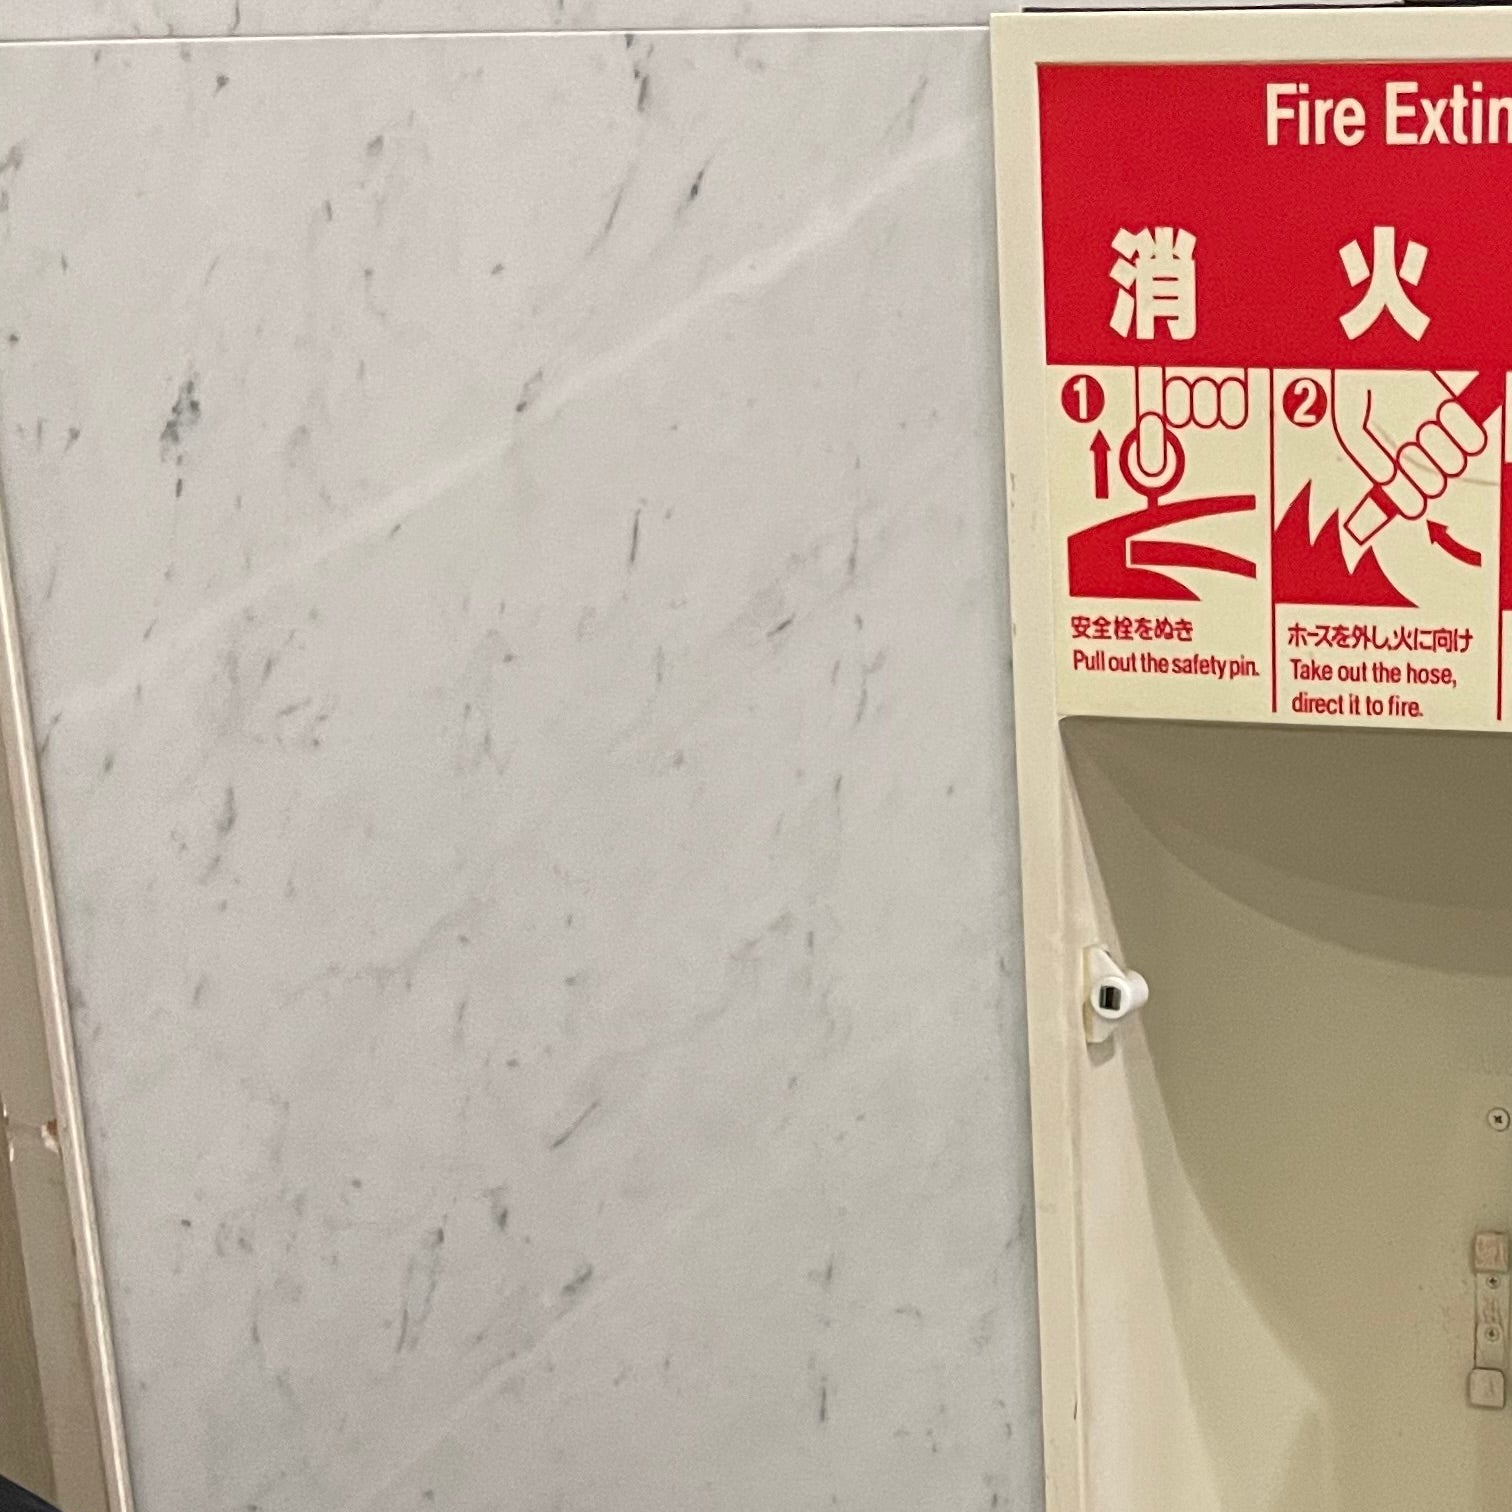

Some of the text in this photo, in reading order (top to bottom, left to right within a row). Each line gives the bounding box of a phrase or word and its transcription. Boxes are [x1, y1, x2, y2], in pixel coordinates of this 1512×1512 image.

[1266, 82, 1366, 146] Fire
[1070, 615, 1194, 642] 安全栓をぬき
[1073, 649, 1260, 680] Pull out the safety pin.
[1290, 658, 1457, 688] Take out the hose,
[1291, 691, 1424, 718] direct it to fire.
